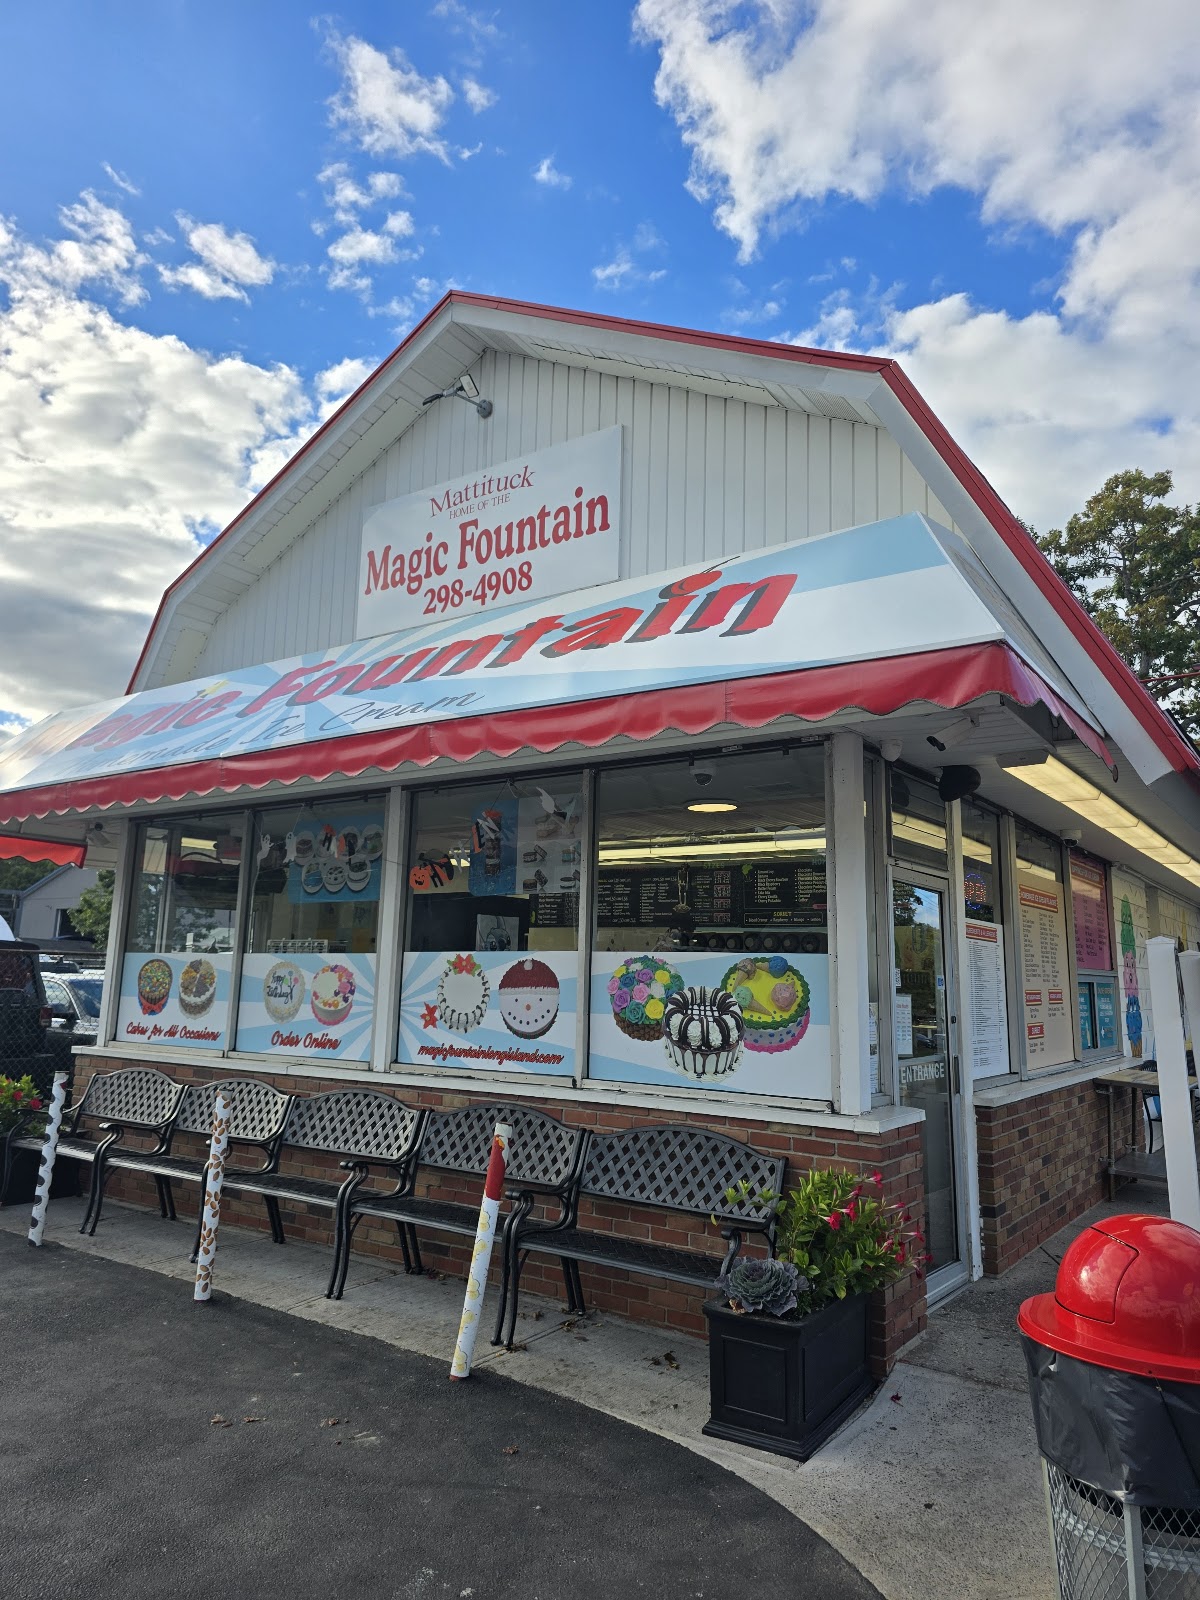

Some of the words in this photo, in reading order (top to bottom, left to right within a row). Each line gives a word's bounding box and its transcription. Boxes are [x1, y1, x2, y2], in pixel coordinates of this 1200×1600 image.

[430, 465, 535, 517] Mattituck
[449, 504, 475, 519] HOME
[477, 500, 490, 511] OF
[491, 493, 511, 507] THE
[364, 532, 449, 595] Magic
[457, 486, 611, 570] Fountain
[423, 561, 533, 615] 298-4908
[236, 568, 798, 718] Fountain
[240, 714, 305, 745] Ice
[319, 691, 486, 731] Cream
[963, 881, 987, 903] OPEN
[126, 1021, 149, 1036] Cakes
[147, 1024, 164, 1041] for
[180, 1025, 222, 1042] Occasions
[271, 1030, 303, 1048] Order
[303, 1032, 342, 1051] Online
[900, 1062, 945, 1084] ENTRANCE
